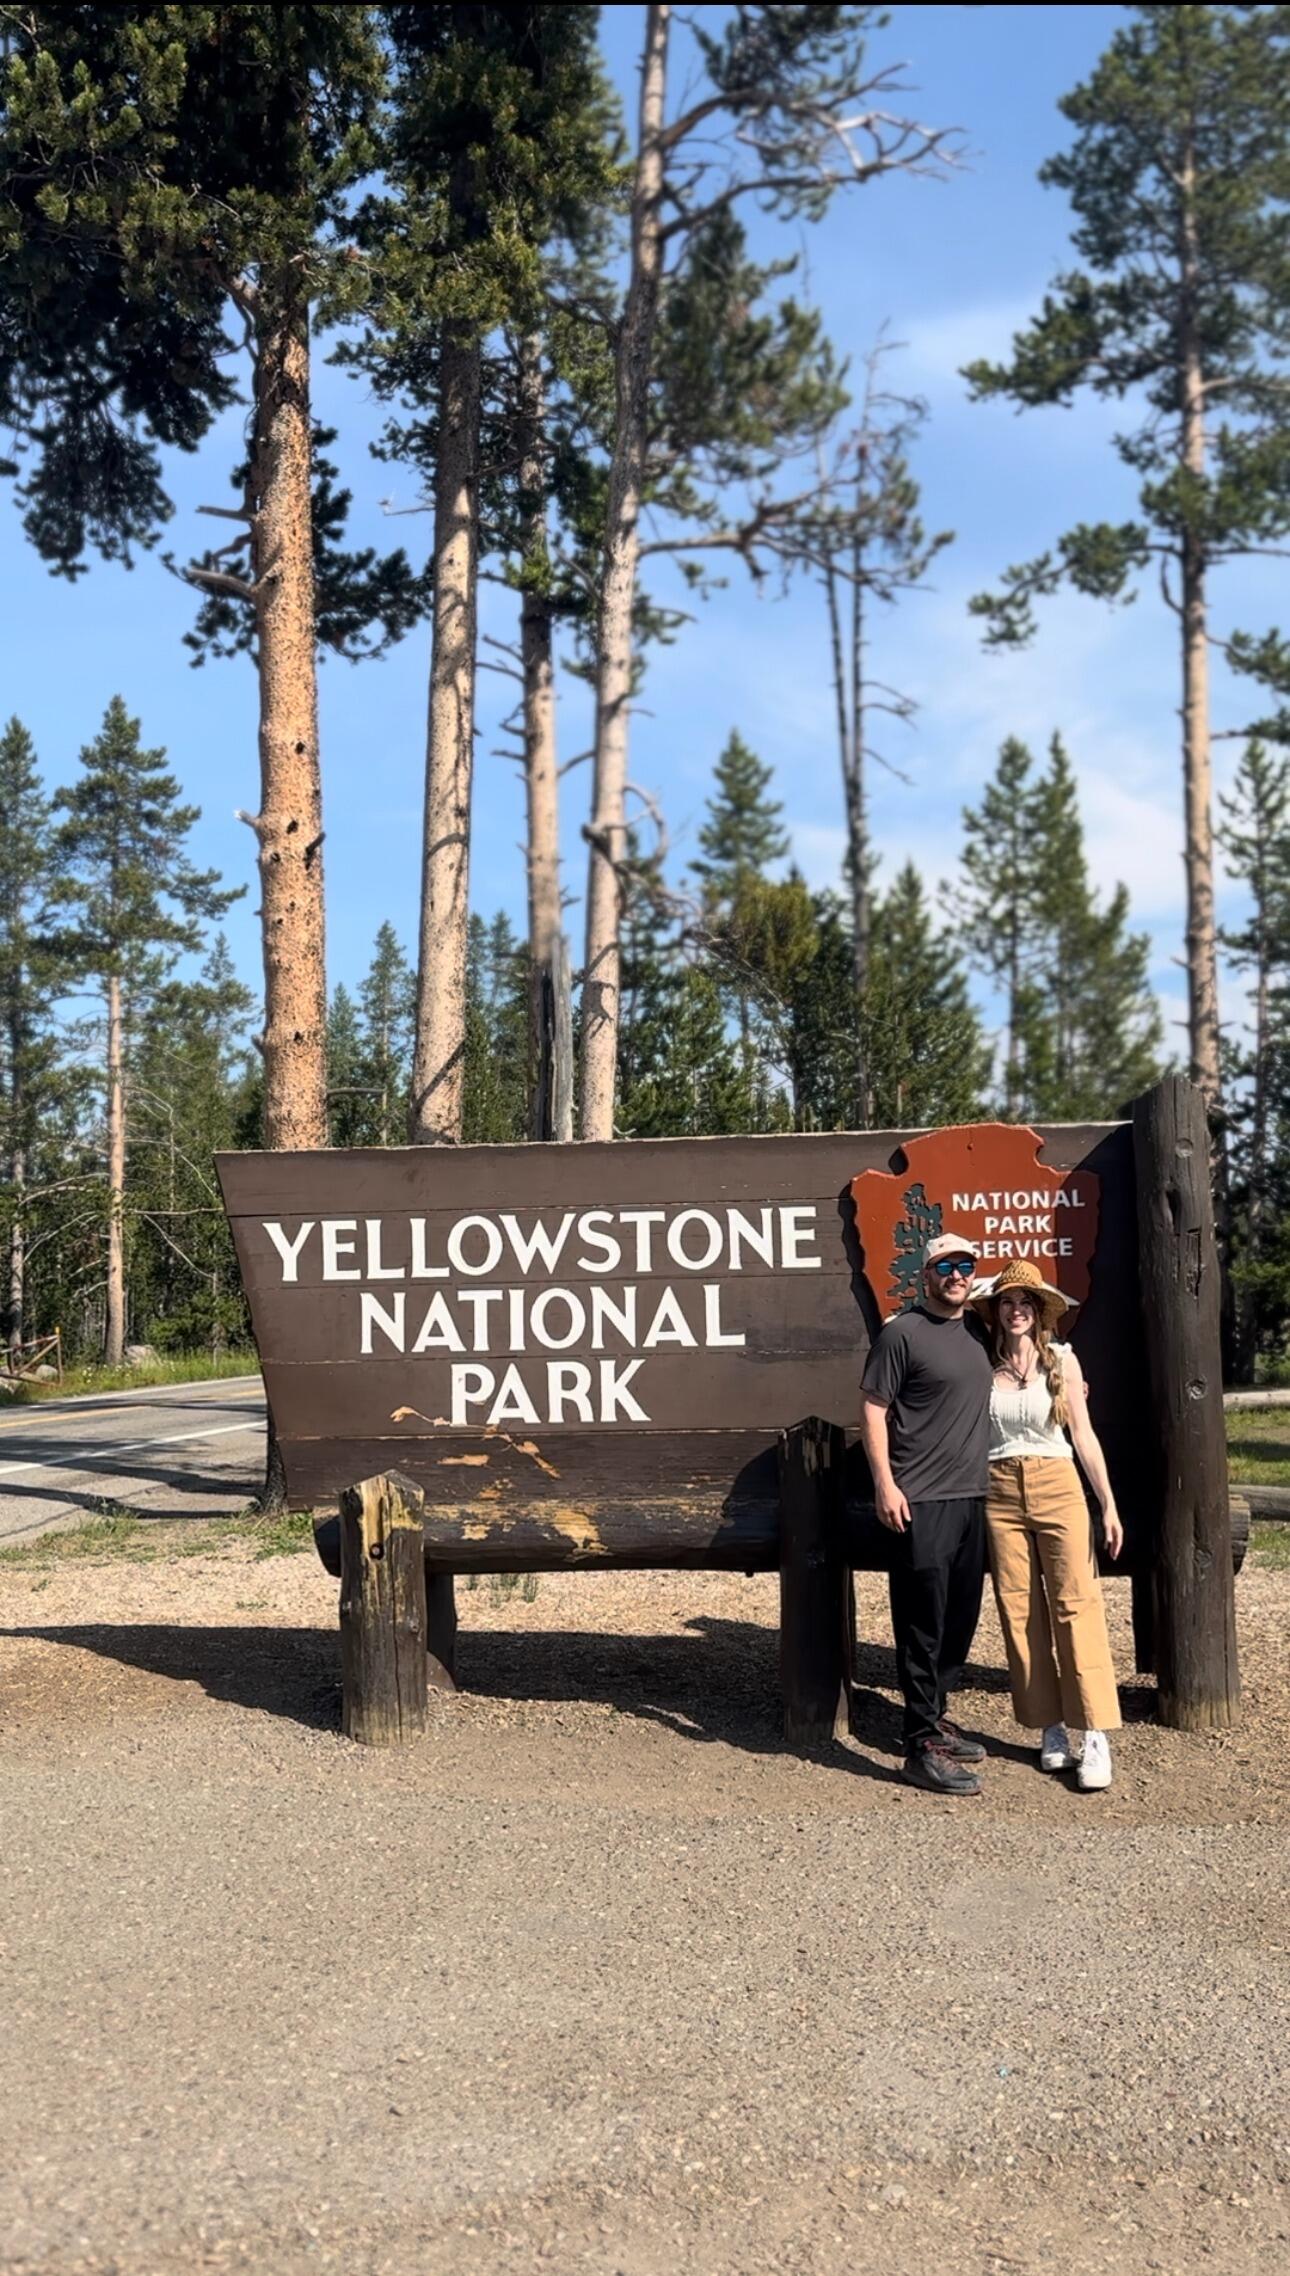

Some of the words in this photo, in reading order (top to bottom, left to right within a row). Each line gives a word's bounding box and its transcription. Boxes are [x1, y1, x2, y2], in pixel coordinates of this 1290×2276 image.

[952, 1189, 1085, 1211] NATIONAL
[263, 1206, 822, 1281] YELLOWSTONE
[985, 1214, 1051, 1234] PARK
[970, 1238, 1073, 1259] SERVICE
[360, 1284, 746, 1353] NATIONAL
[451, 1359, 651, 1426] PARK
